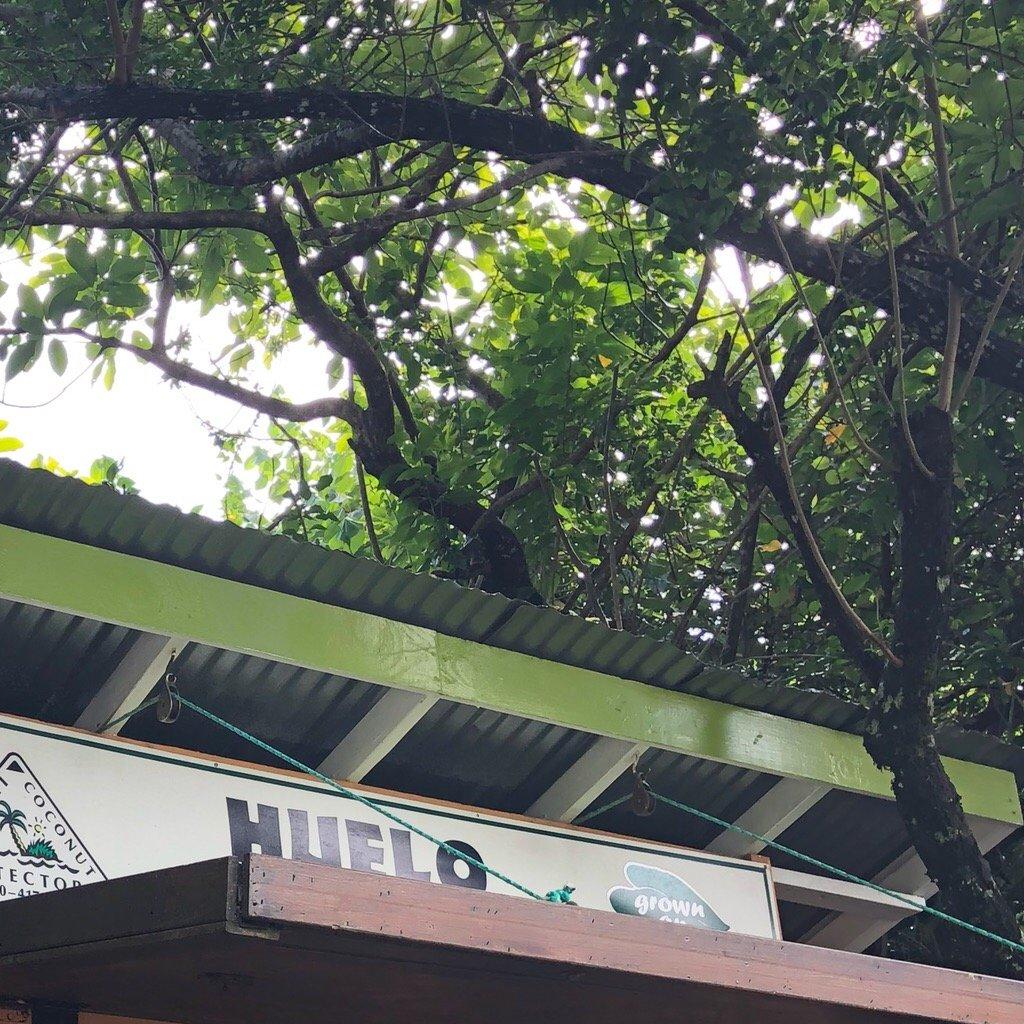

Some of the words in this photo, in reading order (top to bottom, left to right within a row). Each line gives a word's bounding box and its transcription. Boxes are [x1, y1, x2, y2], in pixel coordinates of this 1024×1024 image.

[23, 781, 96, 878] COCONUT
[226, 797, 487, 890] HUELO
[634, 894, 706, 918] grown
